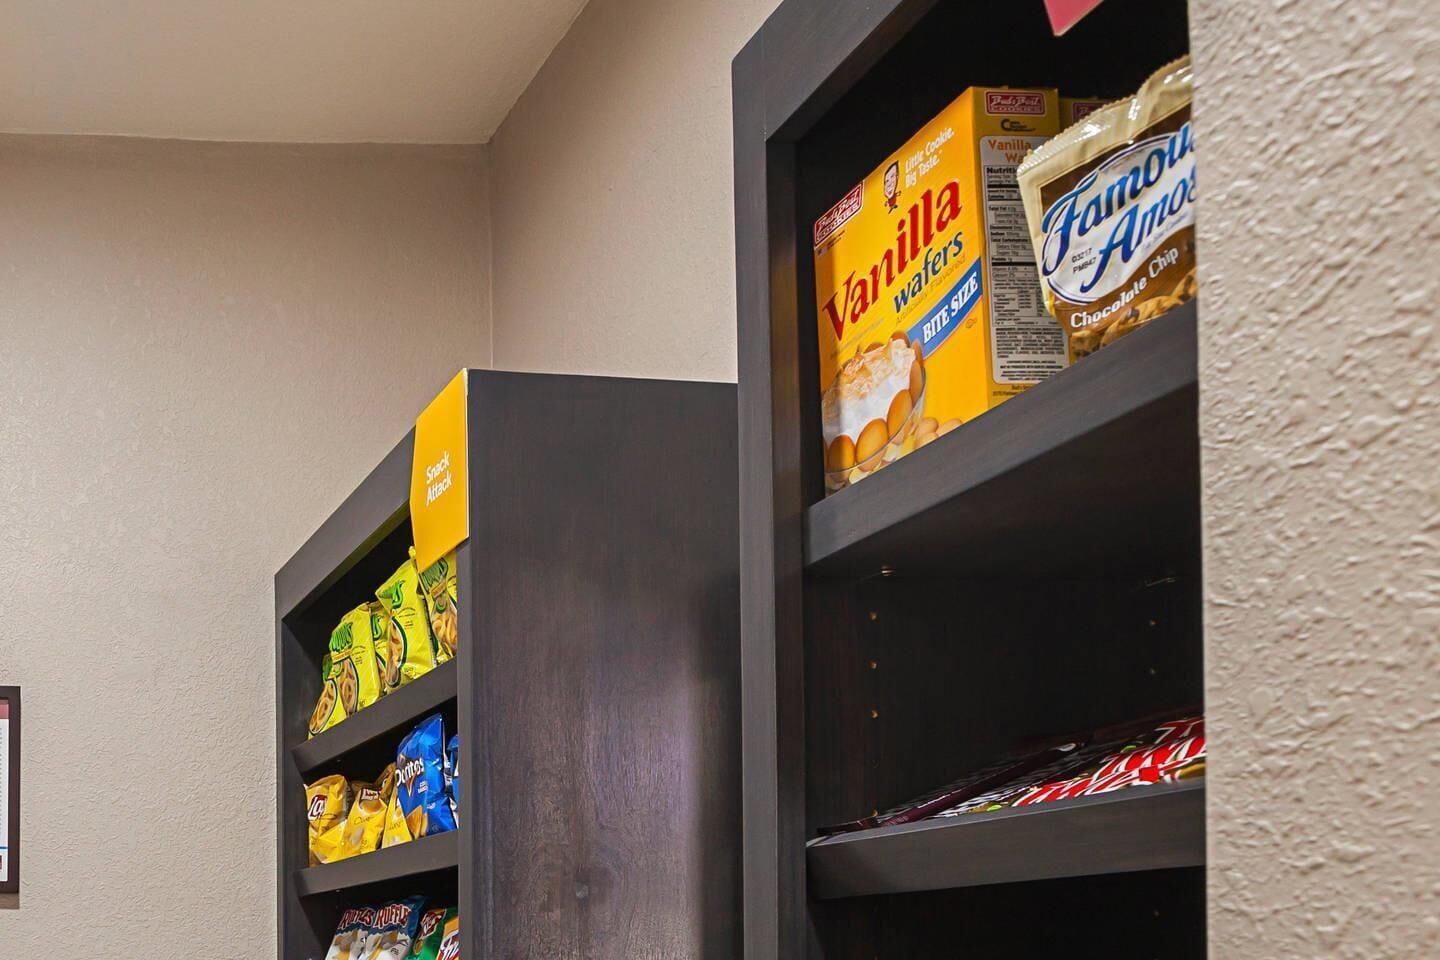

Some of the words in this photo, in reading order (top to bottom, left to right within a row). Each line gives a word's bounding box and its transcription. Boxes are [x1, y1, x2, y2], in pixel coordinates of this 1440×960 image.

[987, 139, 1031, 151] Vanilla
[1042, 122, 1194, 276] Famou
[823, 181, 963, 341] Vanilla
[894, 232, 964, 313] wafers
[1070, 277, 1147, 328] Chocolate
[1149, 247, 1179, 278] Chip
[922, 305, 950, 344] BITE
[951, 271, 978, 317] SIZE
[426, 450, 450, 484] Snack
[426, 470, 452, 506] Attack
[373, 903, 411, 929] RUFFLE
